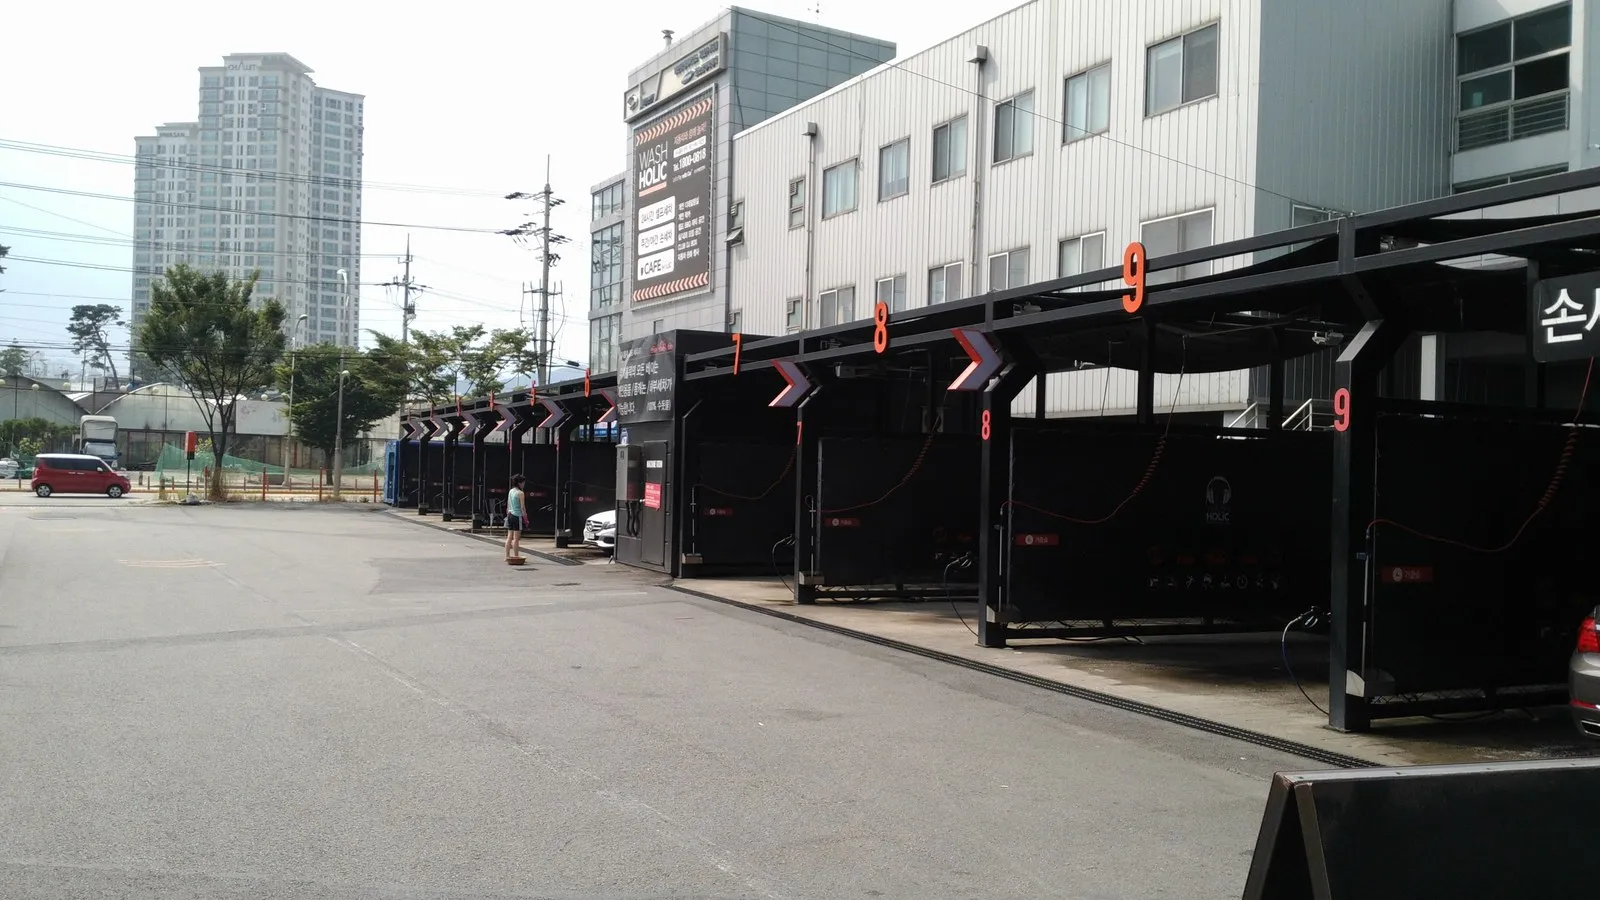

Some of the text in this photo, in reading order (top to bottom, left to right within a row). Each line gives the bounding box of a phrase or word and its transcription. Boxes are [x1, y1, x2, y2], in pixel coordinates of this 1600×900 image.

[639, 140, 668, 171] WASH
[639, 160, 668, 189] HOLIC
[644, 259, 662, 275] CAFE
[1122, 242, 1147, 313] 9
[874, 301, 889, 353] 8
[732, 333, 741, 376] 7
[981, 409, 991, 441] 8
[1334, 388, 1351, 432] 9
[796, 421, 803, 446] 7
